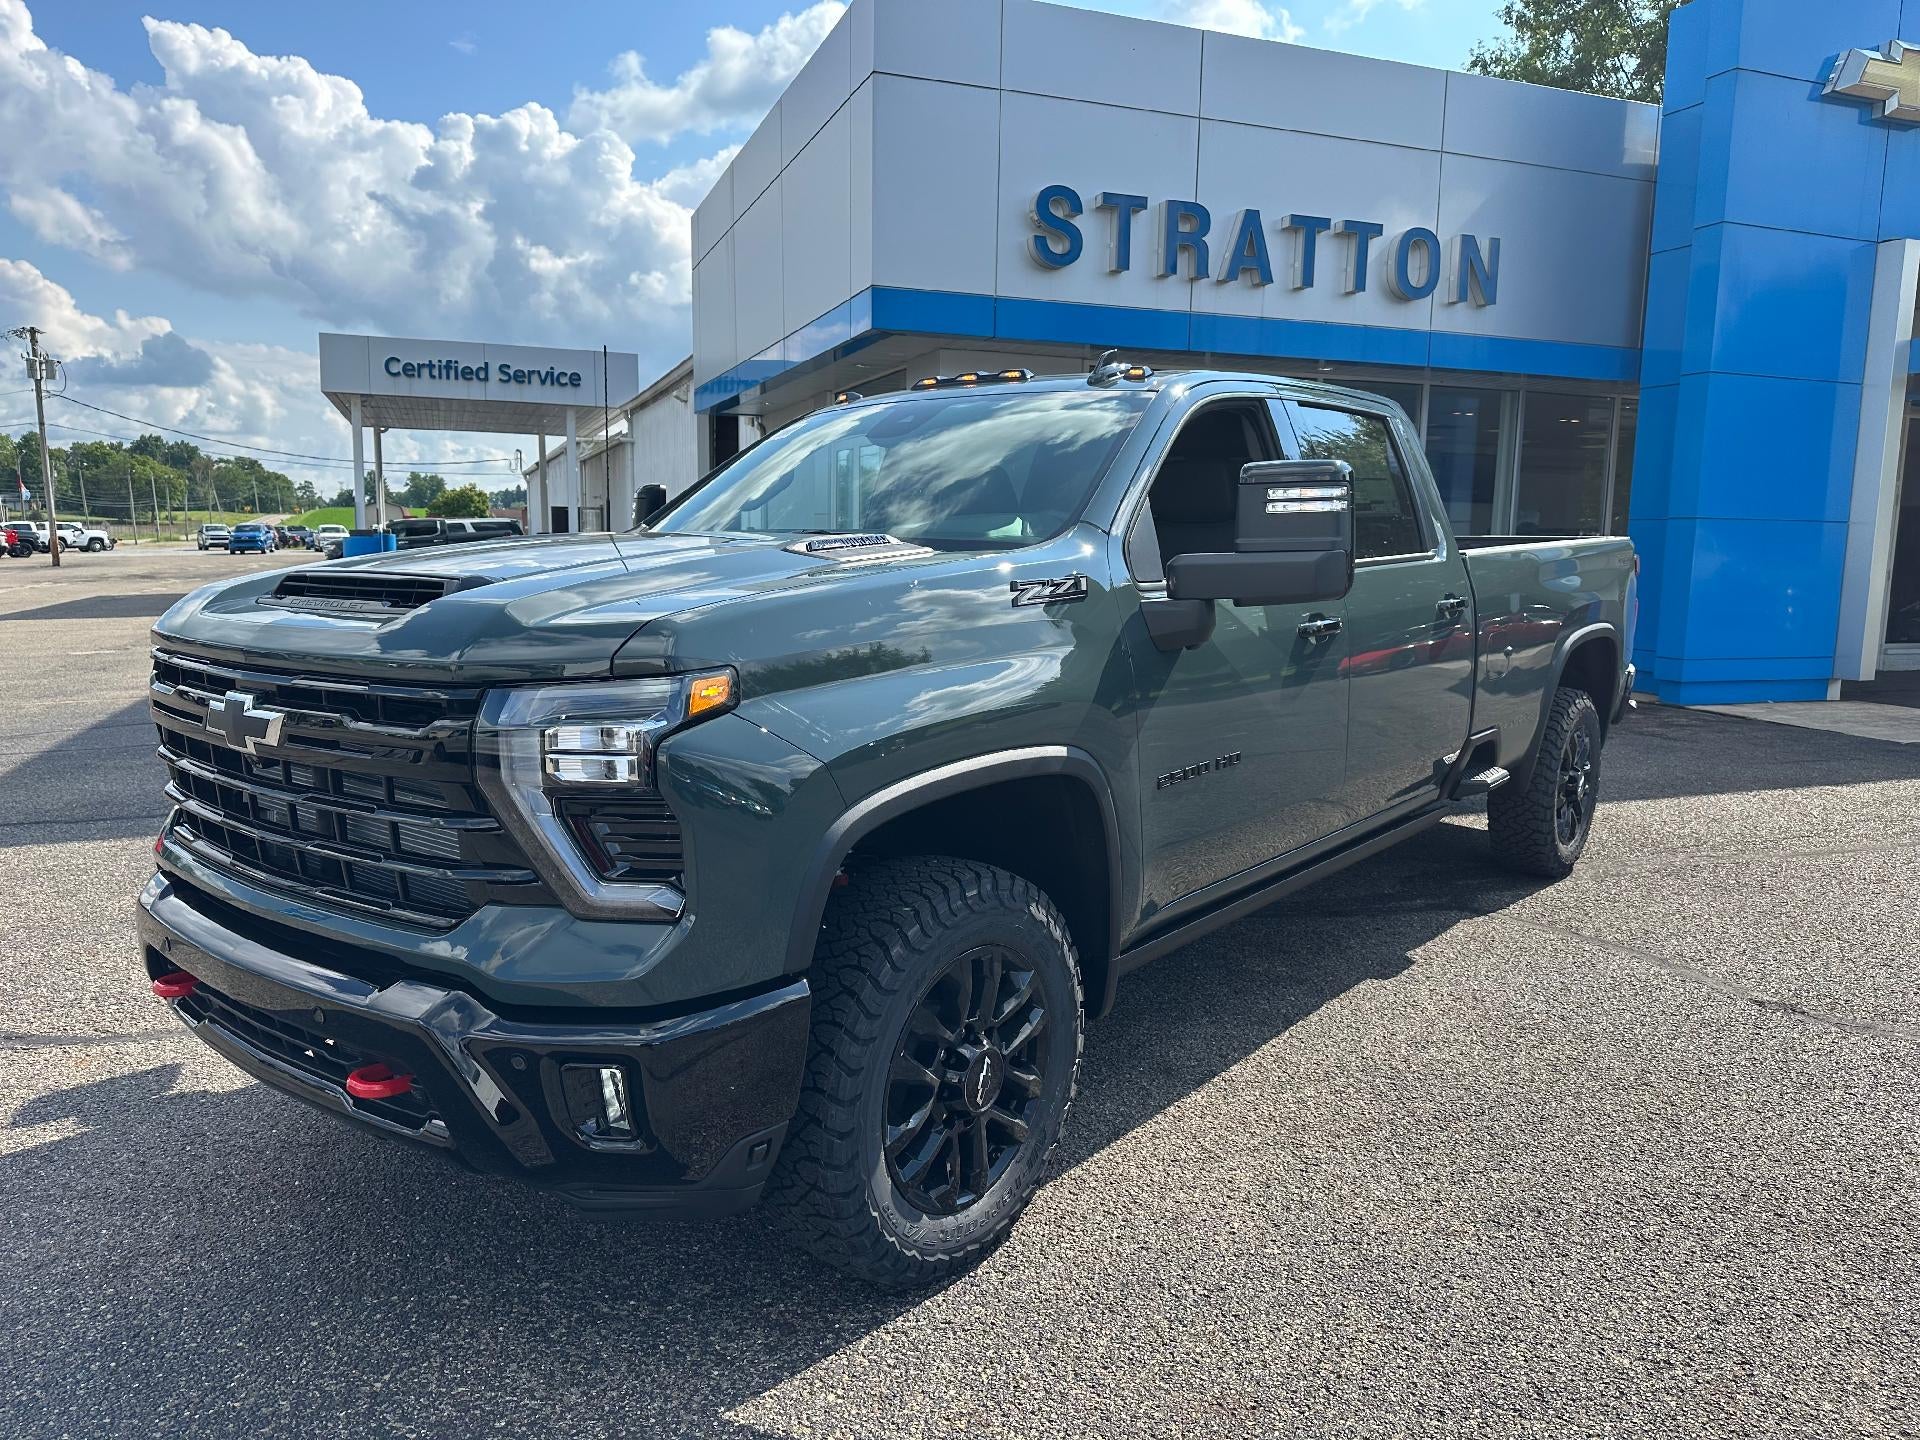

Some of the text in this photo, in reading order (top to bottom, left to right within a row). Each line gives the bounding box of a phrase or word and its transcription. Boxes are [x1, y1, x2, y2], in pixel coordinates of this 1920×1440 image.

[1027, 184, 1501, 307] STRATTON
[384, 356, 582, 387] Certified Service
[289, 598, 369, 610] CHEVROLET
[1010, 575, 1088, 607] Z71
[1215, 751, 1241, 771] HD
